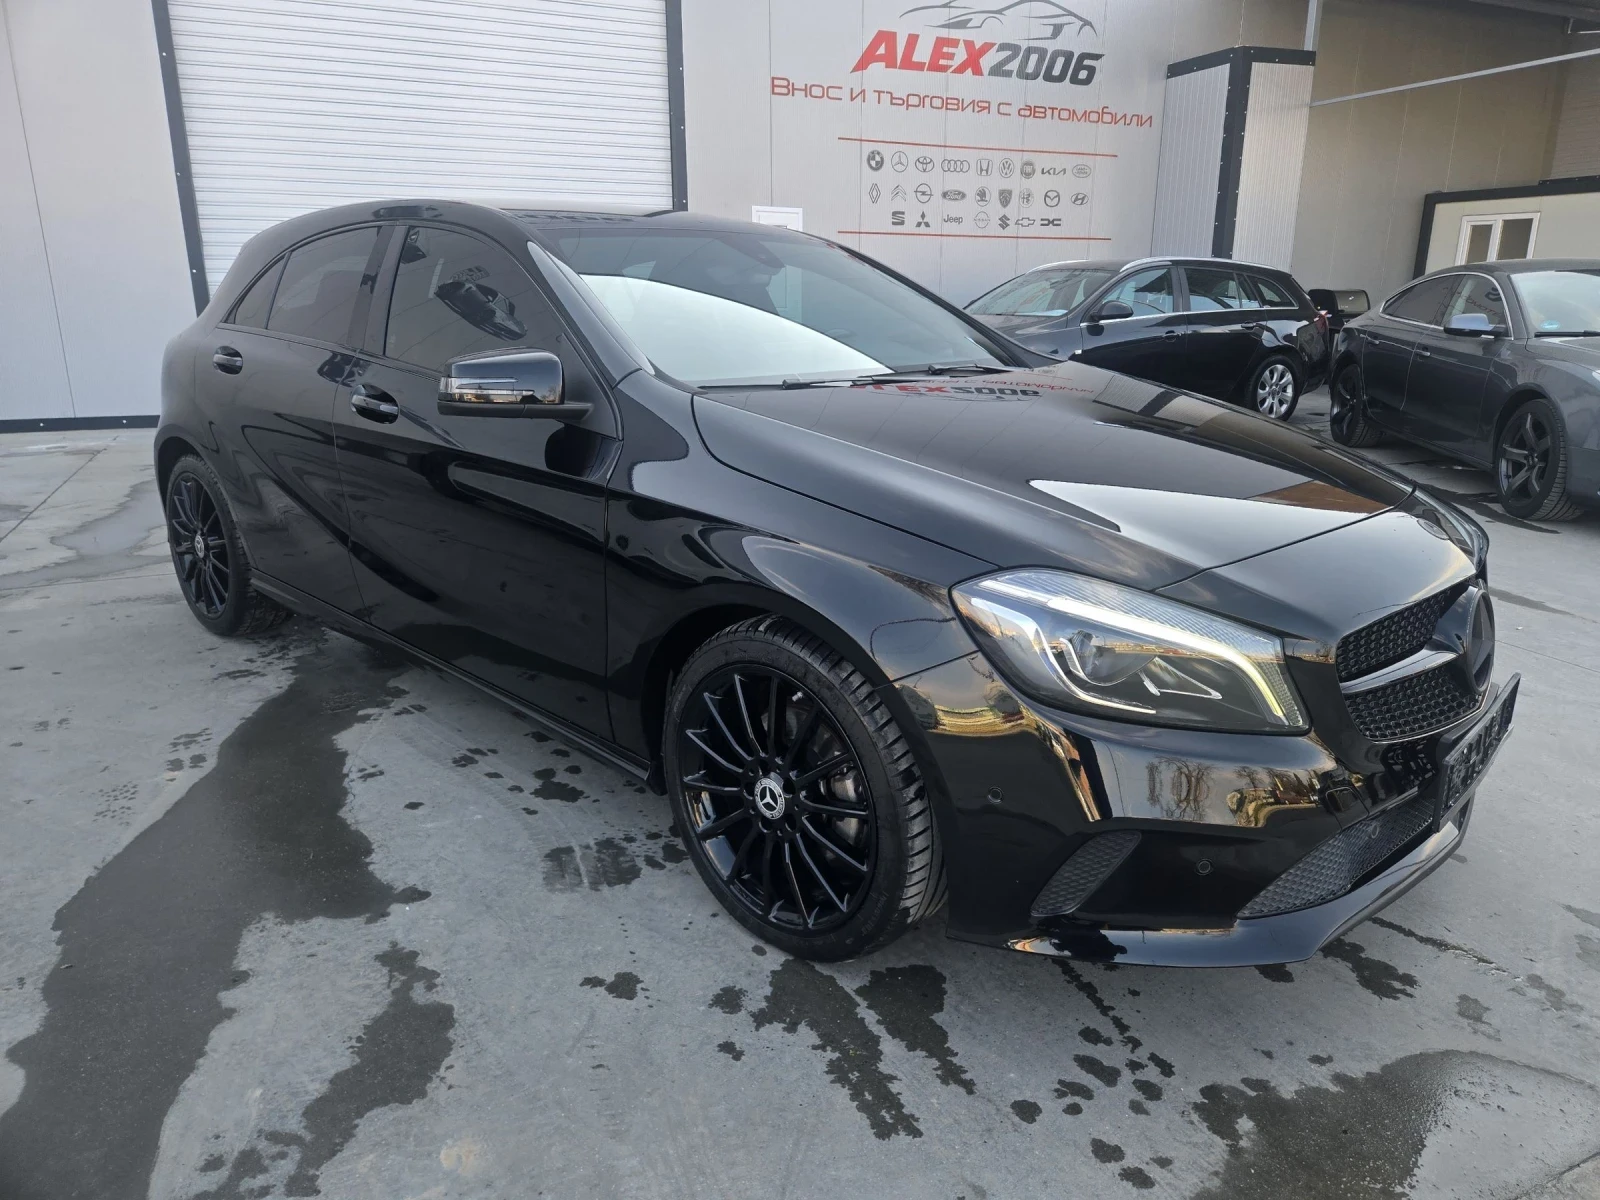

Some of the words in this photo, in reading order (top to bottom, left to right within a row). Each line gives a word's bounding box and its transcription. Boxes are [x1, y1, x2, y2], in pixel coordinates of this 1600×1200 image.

[850, 29, 1106, 86] ALEX2006
[771, 76, 843, 101] Внос
[850, 87, 866, 103] и
[873, 89, 991, 115] търговия
[997, 102, 1012, 117] с
[1017, 104, 1153, 128] автомобили
[943, 214, 964, 225] Jeep
